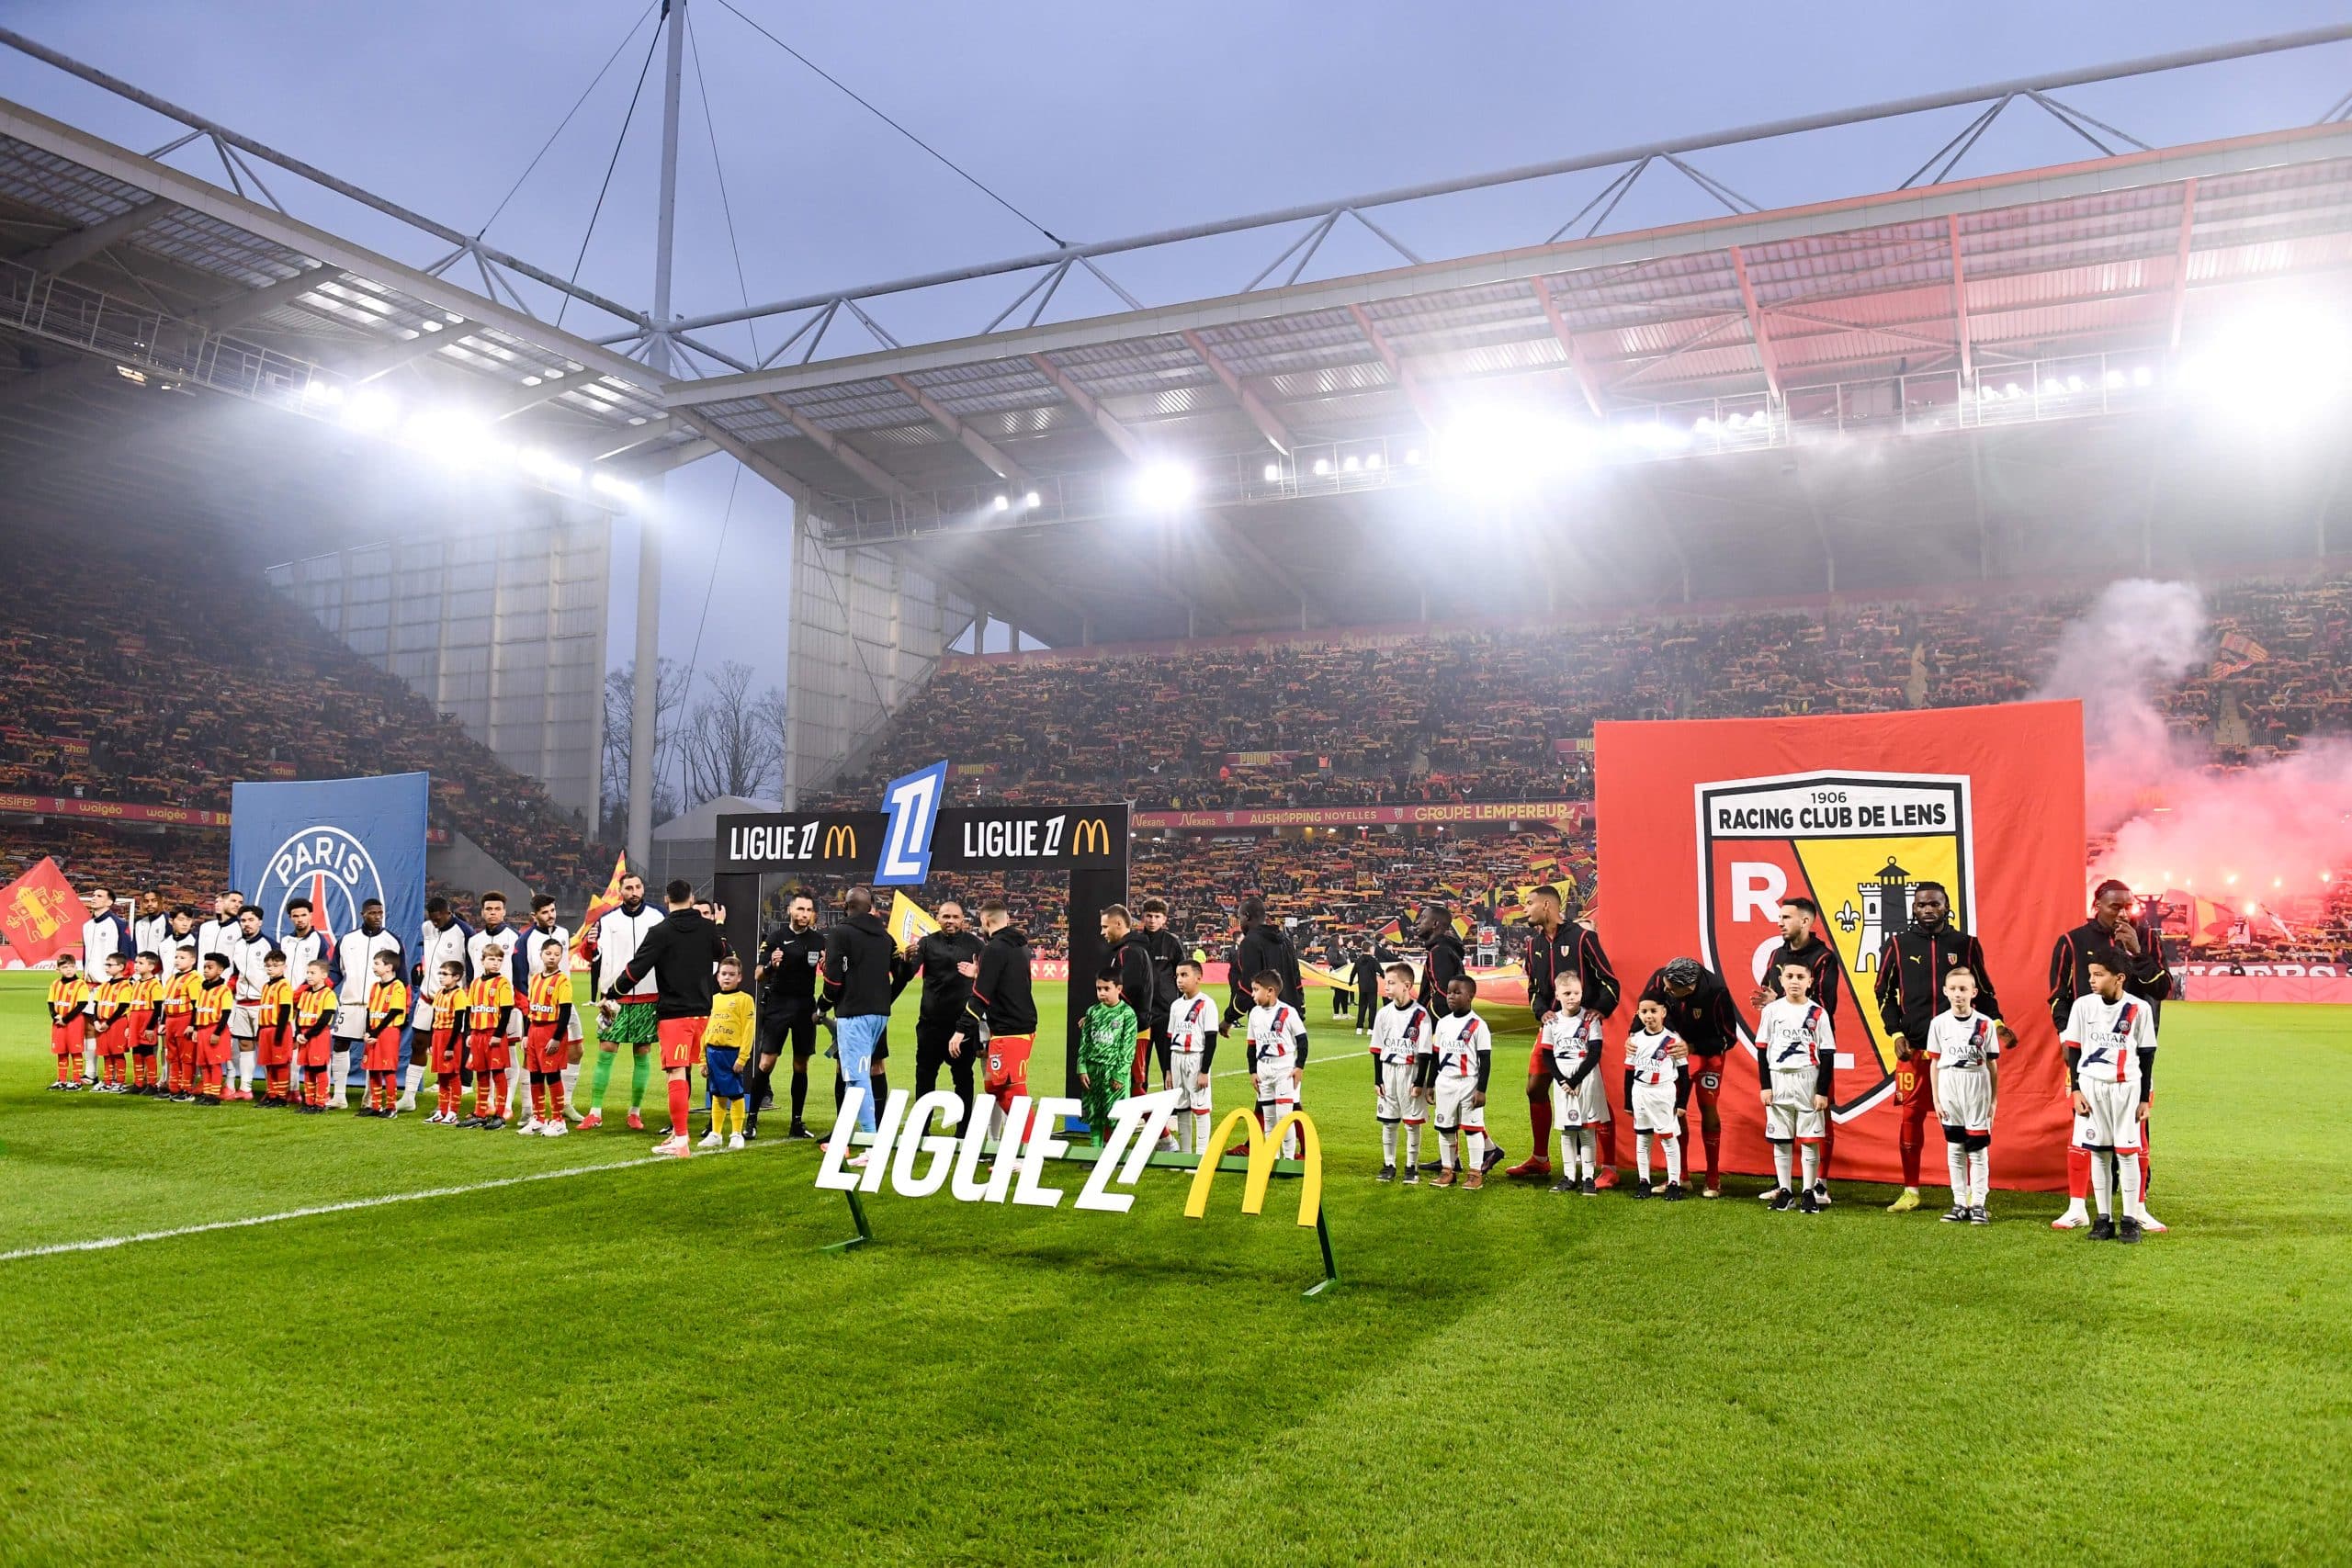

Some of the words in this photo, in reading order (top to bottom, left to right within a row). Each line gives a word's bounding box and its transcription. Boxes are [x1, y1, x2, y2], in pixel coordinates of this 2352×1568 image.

[63, 743, 89, 754] chan
[1811, 791, 1847, 805] 1906
[1132, 814, 1166, 827] Nexans
[1179, 813, 1216, 826] Nexans
[1250, 811, 1322, 825] AUSHOPPING
[1324, 810, 1376, 821] NOYELLES
[1415, 807, 1472, 821] GROUPE
[1476, 804, 1567, 819] LEMPEREUR
[1719, 807, 1794, 829] RACING
[1799, 806, 1853, 829] CLUB
[1858, 806, 1886, 827] DE
[1891, 803, 1947, 826] LENS
[729, 824, 795, 861] LIGUE
[964, 820, 1039, 858] LIGUE
[275, 837, 364, 886] PARIS
[2091, 1032, 2126, 1043] QATAR
[1898, 1072, 1915, 1091] 19
[815, 1087, 1082, 1208] LIGUE
